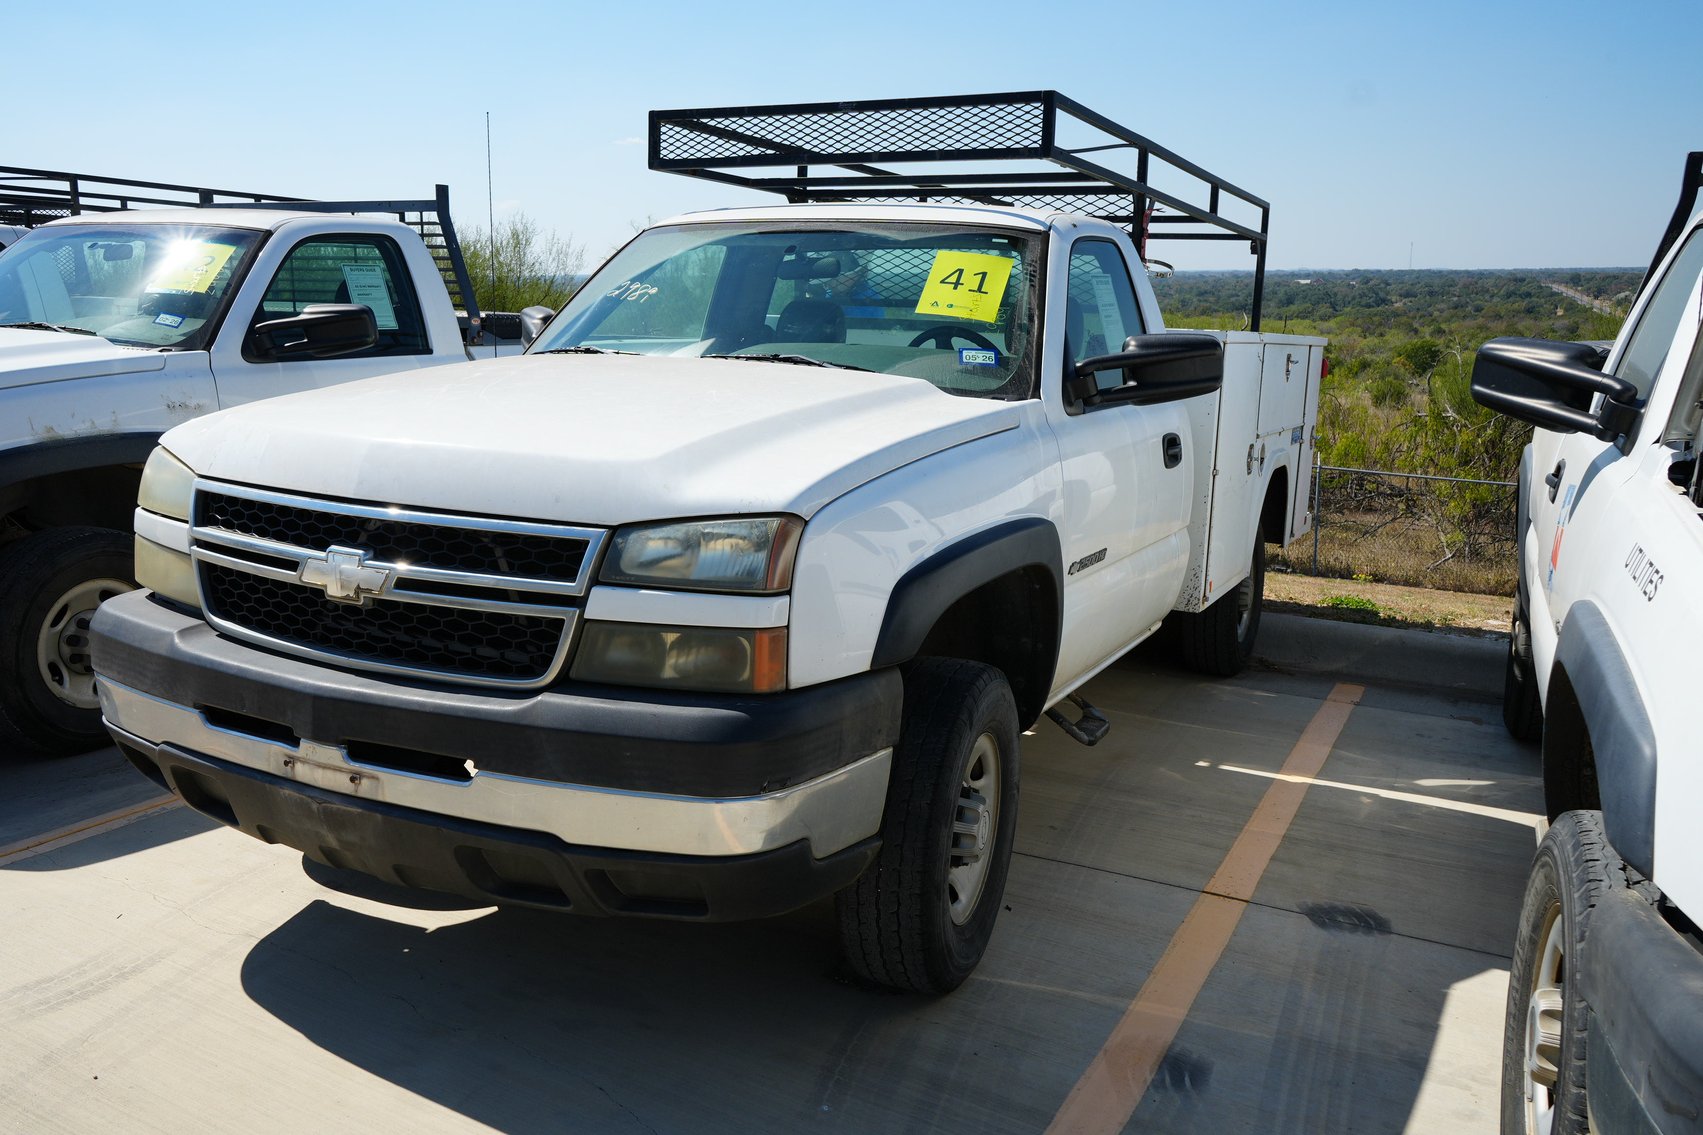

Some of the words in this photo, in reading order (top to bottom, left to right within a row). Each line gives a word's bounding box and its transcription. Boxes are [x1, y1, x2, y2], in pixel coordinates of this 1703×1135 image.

[939, 268, 989, 294] 41
[981, 354, 994, 363] 26
[1624, 542, 1665, 602] UTILITIES
